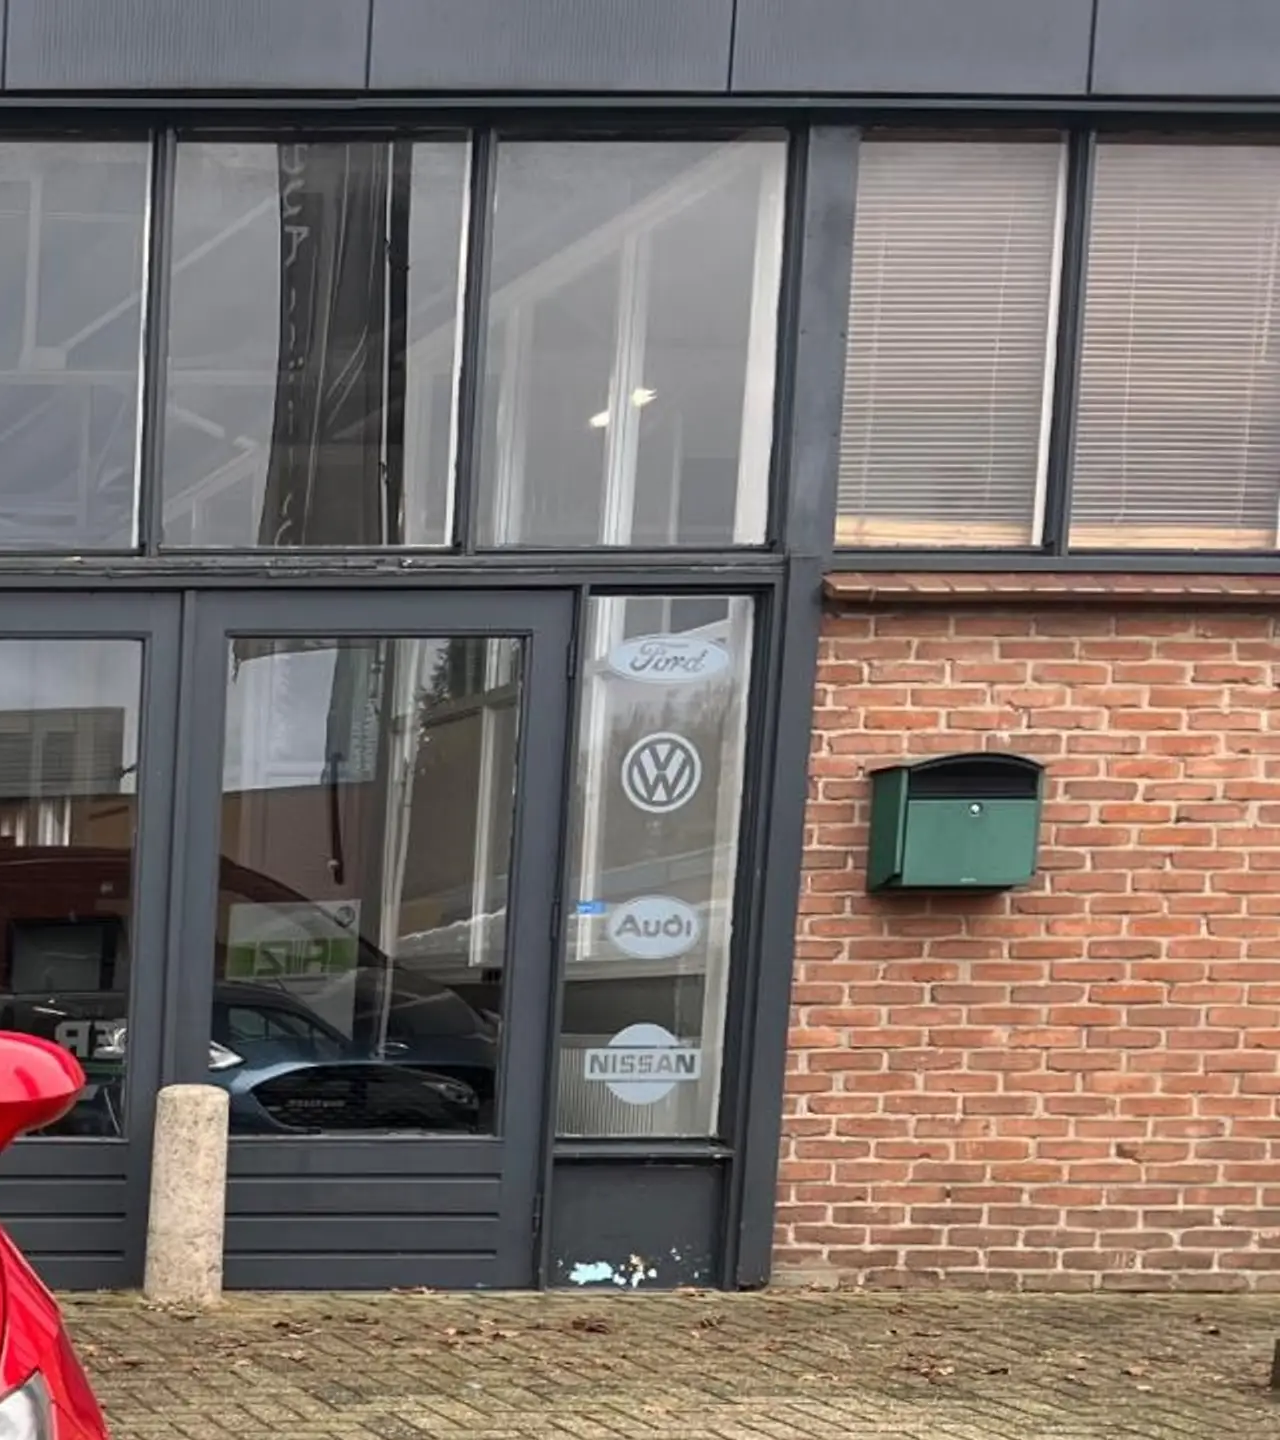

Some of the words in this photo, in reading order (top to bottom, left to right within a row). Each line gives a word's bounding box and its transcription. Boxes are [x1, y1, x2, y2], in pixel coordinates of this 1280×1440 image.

[629, 641, 708, 673] Ford
[614, 913, 692, 938] Audi
[589, 1053, 696, 1075] NISSAN
